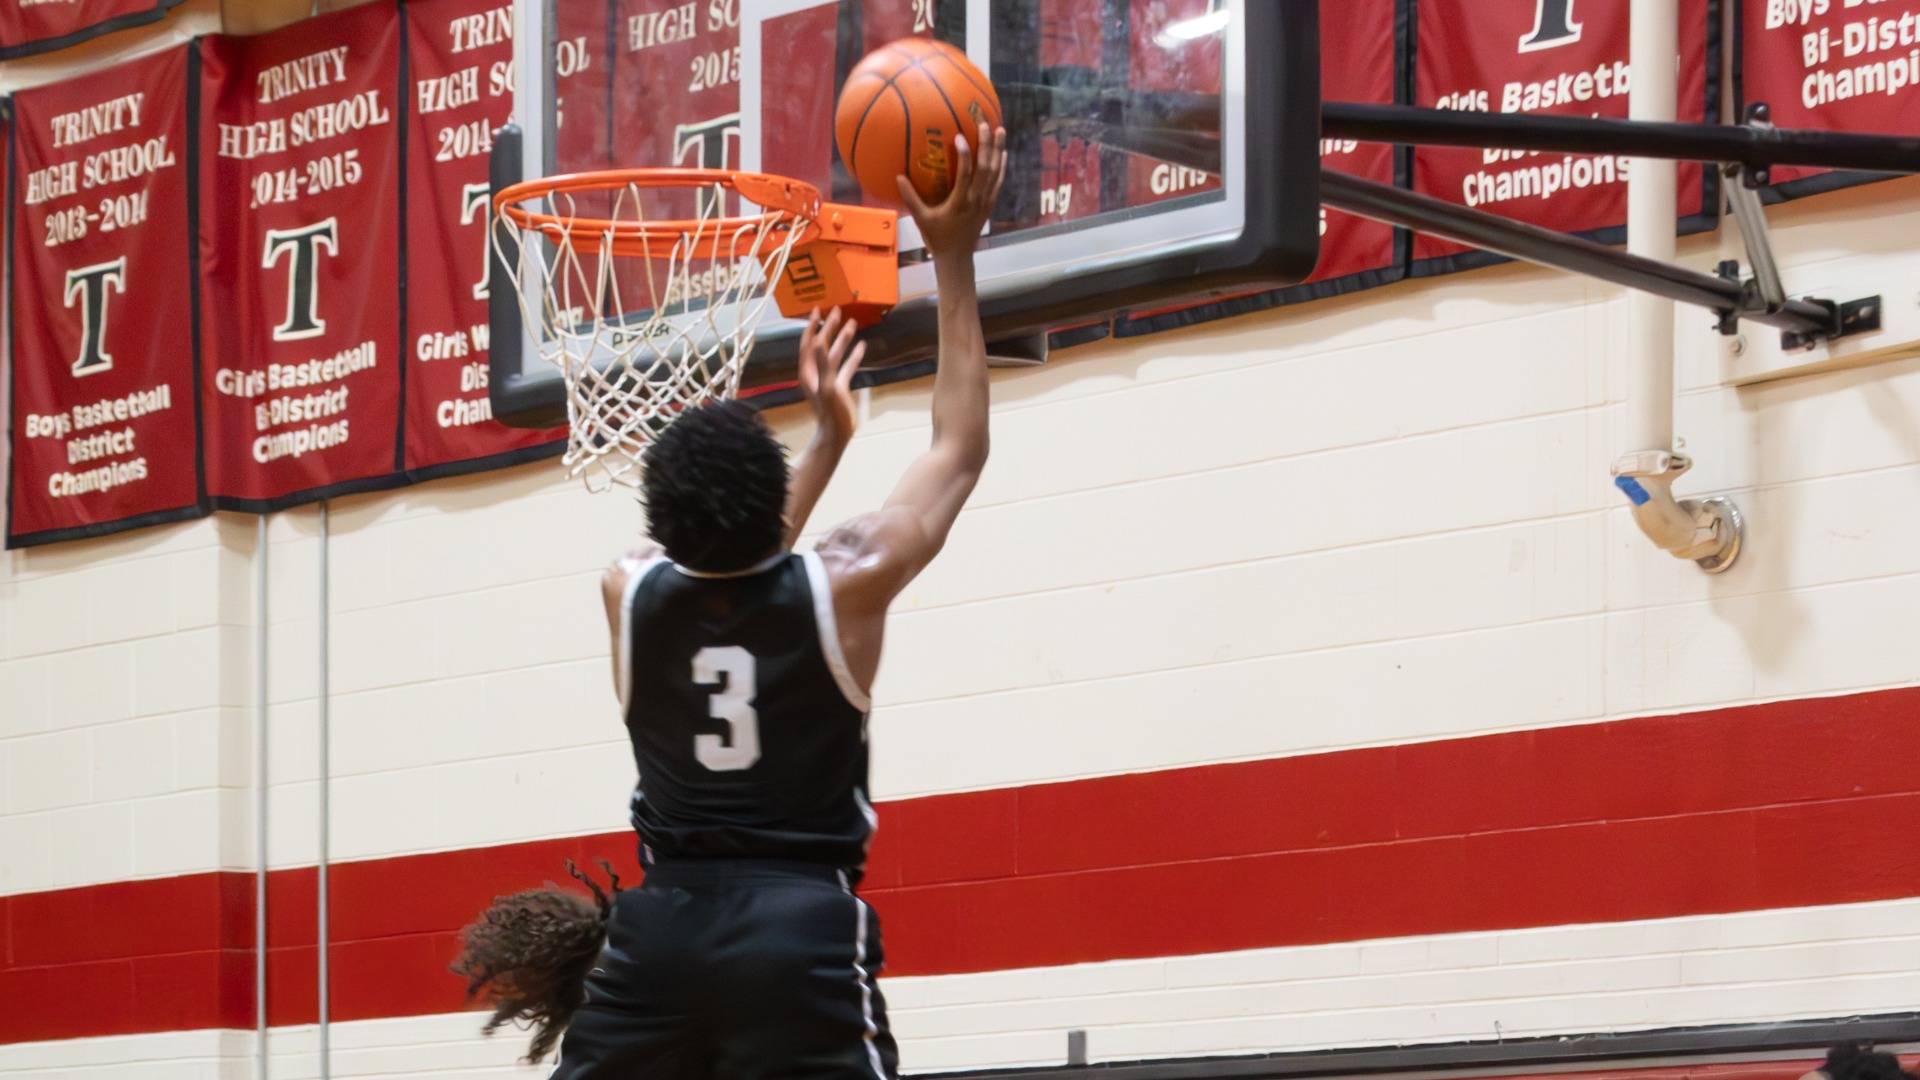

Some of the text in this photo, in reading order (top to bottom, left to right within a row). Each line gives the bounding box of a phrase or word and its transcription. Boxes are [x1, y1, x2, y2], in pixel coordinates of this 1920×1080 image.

[450, 5, 513, 54] TRIN
[628, 2, 697, 51] HIGH
[1765, 0, 1829, 30] Boys
[1802, 11, 1920, 68] Bi-Dist
[257, 45, 349, 104] TRINITY
[417, 66, 480, 114] HIGH
[1501, 61, 1631, 113] Basketb
[1802, 48, 1920, 109] Champi
[51, 92, 144, 148] TRINITY
[290, 89, 389, 147] SCHOOL
[25, 134, 176, 205] HIGH SCHOOL
[250, 149, 362, 209] 014-2015
[416, 331, 469, 361] Girls
[26, 413, 71, 440] Boys
[252, 419, 349, 463] Cmpions
[48, 457, 148, 498] Champions
[691, 645, 762, 771] 3
